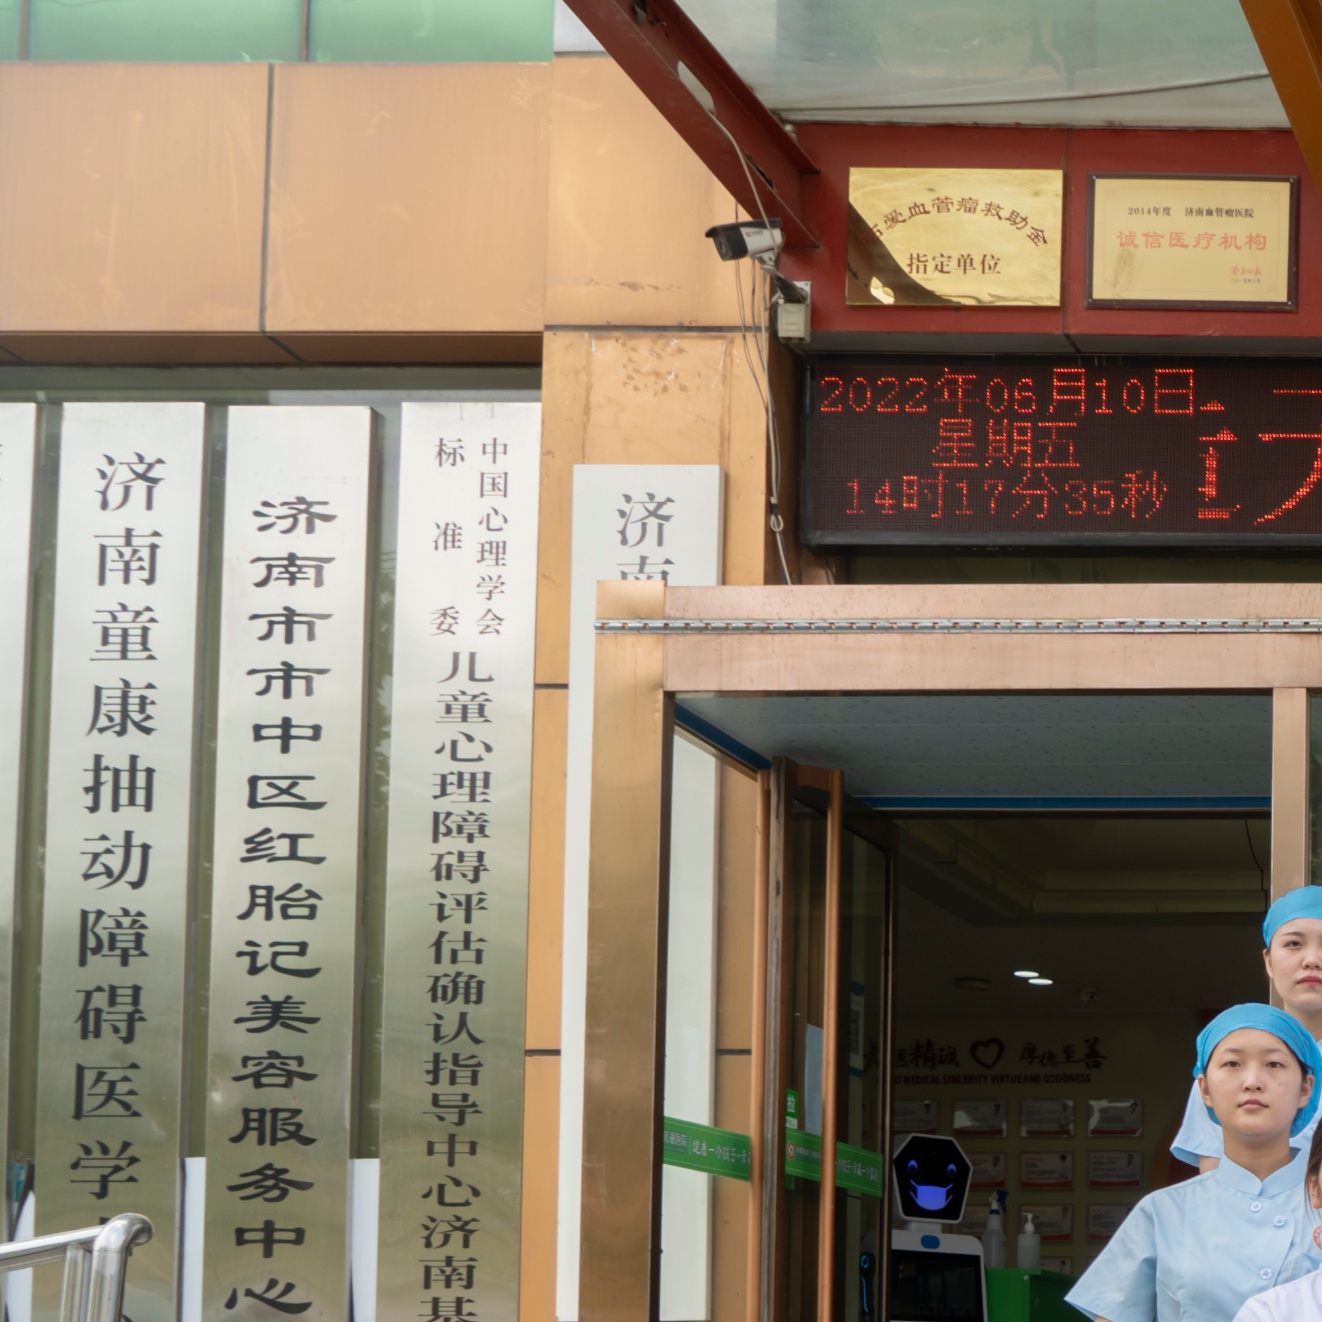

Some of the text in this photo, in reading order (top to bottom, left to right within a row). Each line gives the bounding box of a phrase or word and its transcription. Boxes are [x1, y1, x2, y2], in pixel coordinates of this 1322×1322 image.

[1128, 206, 1171, 217] 2014年度
[907, 253, 1001, 275] 指定单位
[1116, 230, 1267, 250] 诚信医疗机构
[818, 367, 1195, 416] 2022年06月10日
[931, 418, 1082, 469] 星期五
[844, 474, 1168, 521] 14时17分35秒
[430, 437, 465, 636] 标准委
[475, 437, 510, 636] 中国心理学会
[225, 496, 338, 1315] 济南市市中区红胎记美容服务中心
